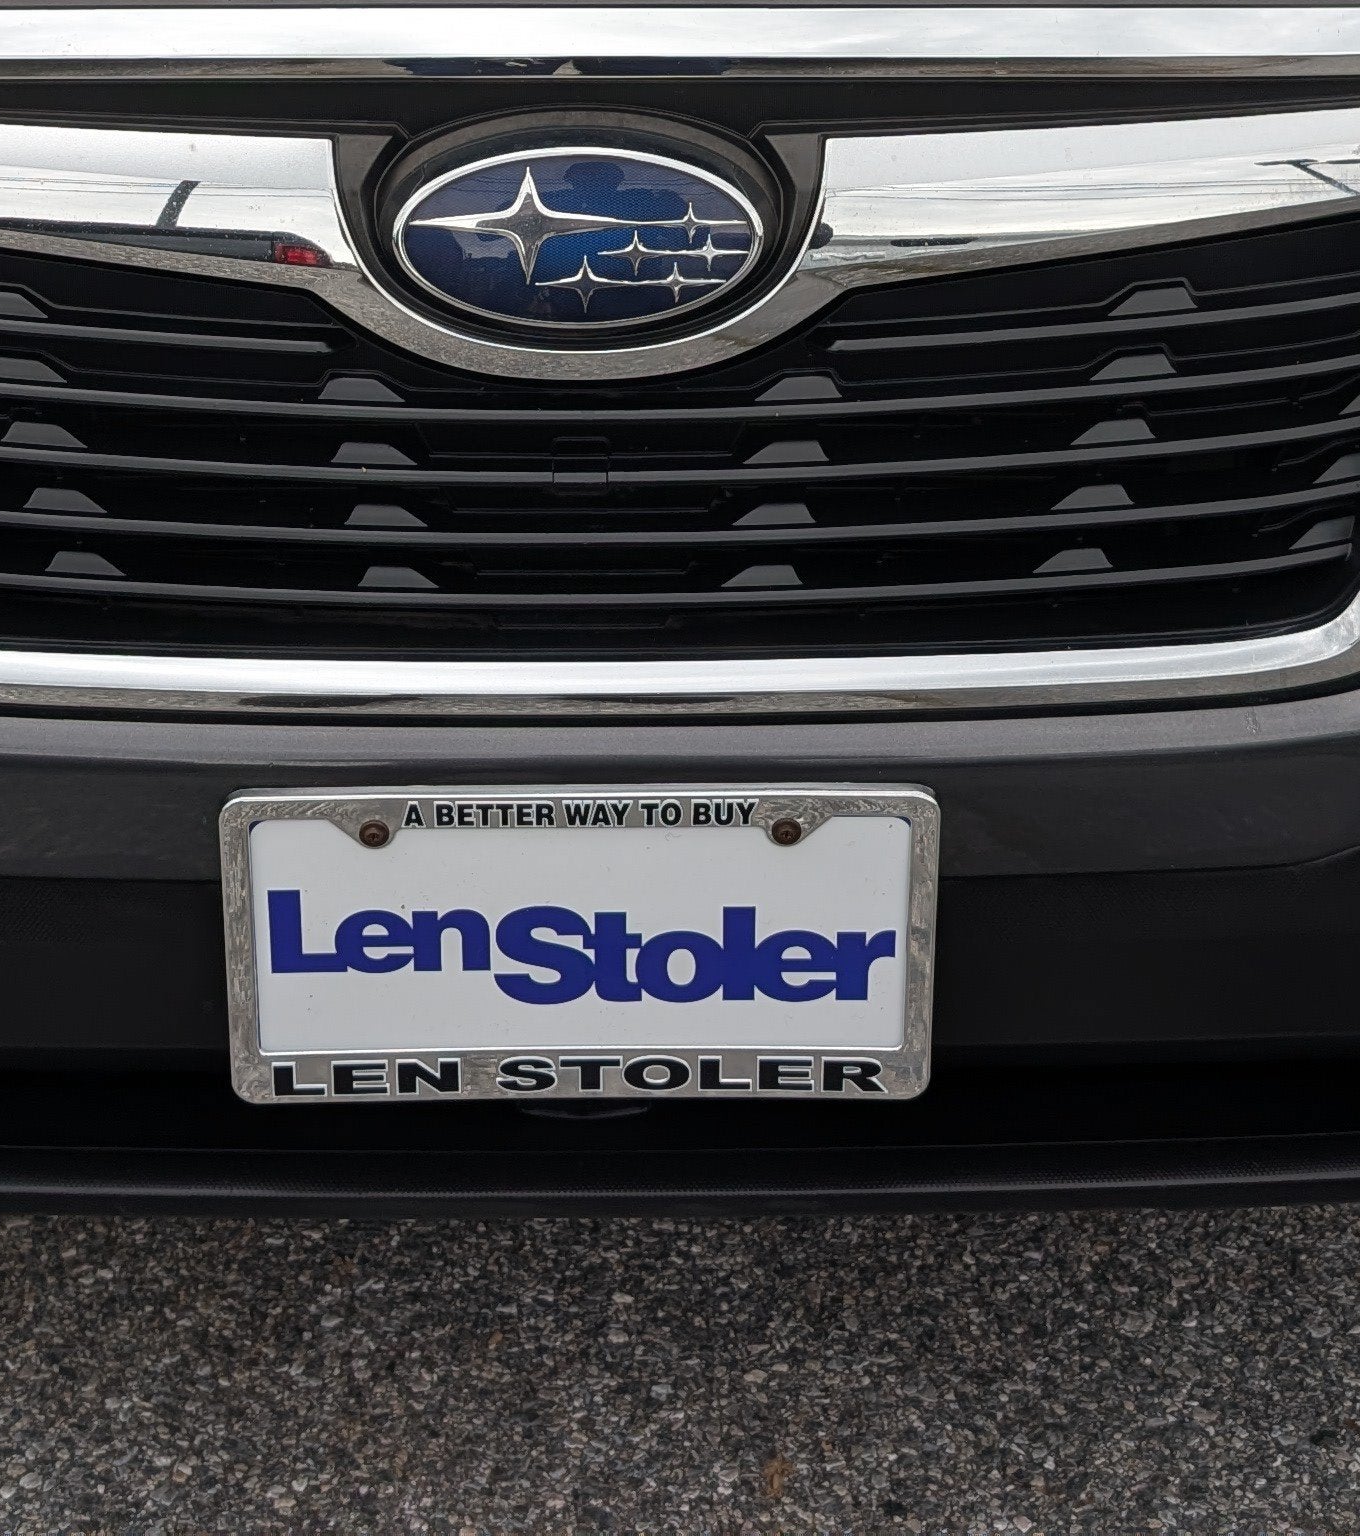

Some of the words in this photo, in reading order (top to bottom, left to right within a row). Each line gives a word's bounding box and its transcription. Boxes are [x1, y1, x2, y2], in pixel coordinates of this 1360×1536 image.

[401, 800, 427, 828] A
[433, 800, 557, 827] BETTER
[561, 799, 634, 827] WAY
[640, 801, 683, 826] TO
[690, 798, 760, 826] BUY
[271, 1058, 462, 1097] LEN
[495, 1055, 890, 1096] STOLER
